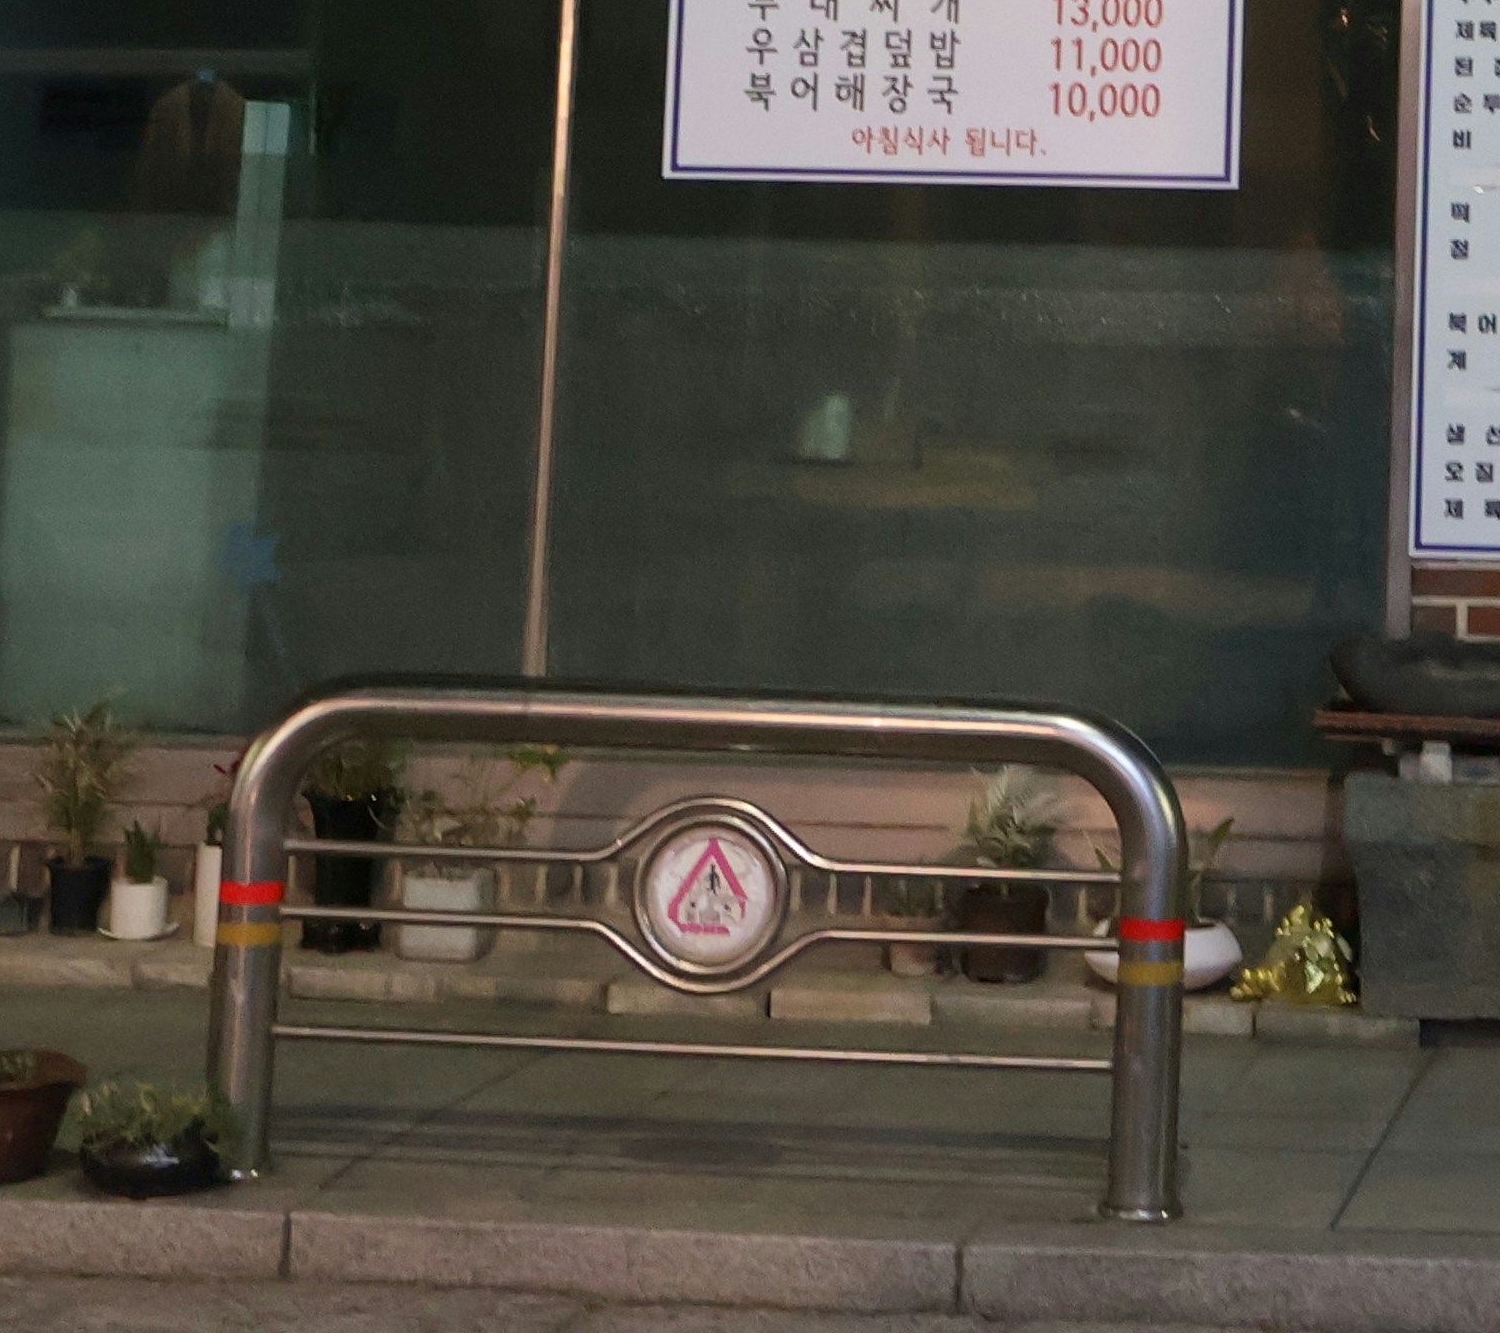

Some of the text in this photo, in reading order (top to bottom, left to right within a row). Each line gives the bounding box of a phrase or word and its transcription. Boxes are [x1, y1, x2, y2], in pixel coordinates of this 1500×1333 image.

[747, 28, 1161, 76] 우삼겹덮밥 11,000
[745, 73, 1160, 121] 북어해장국 10,000
[852, 126, 1045, 156] 아침식사 됩니다.
